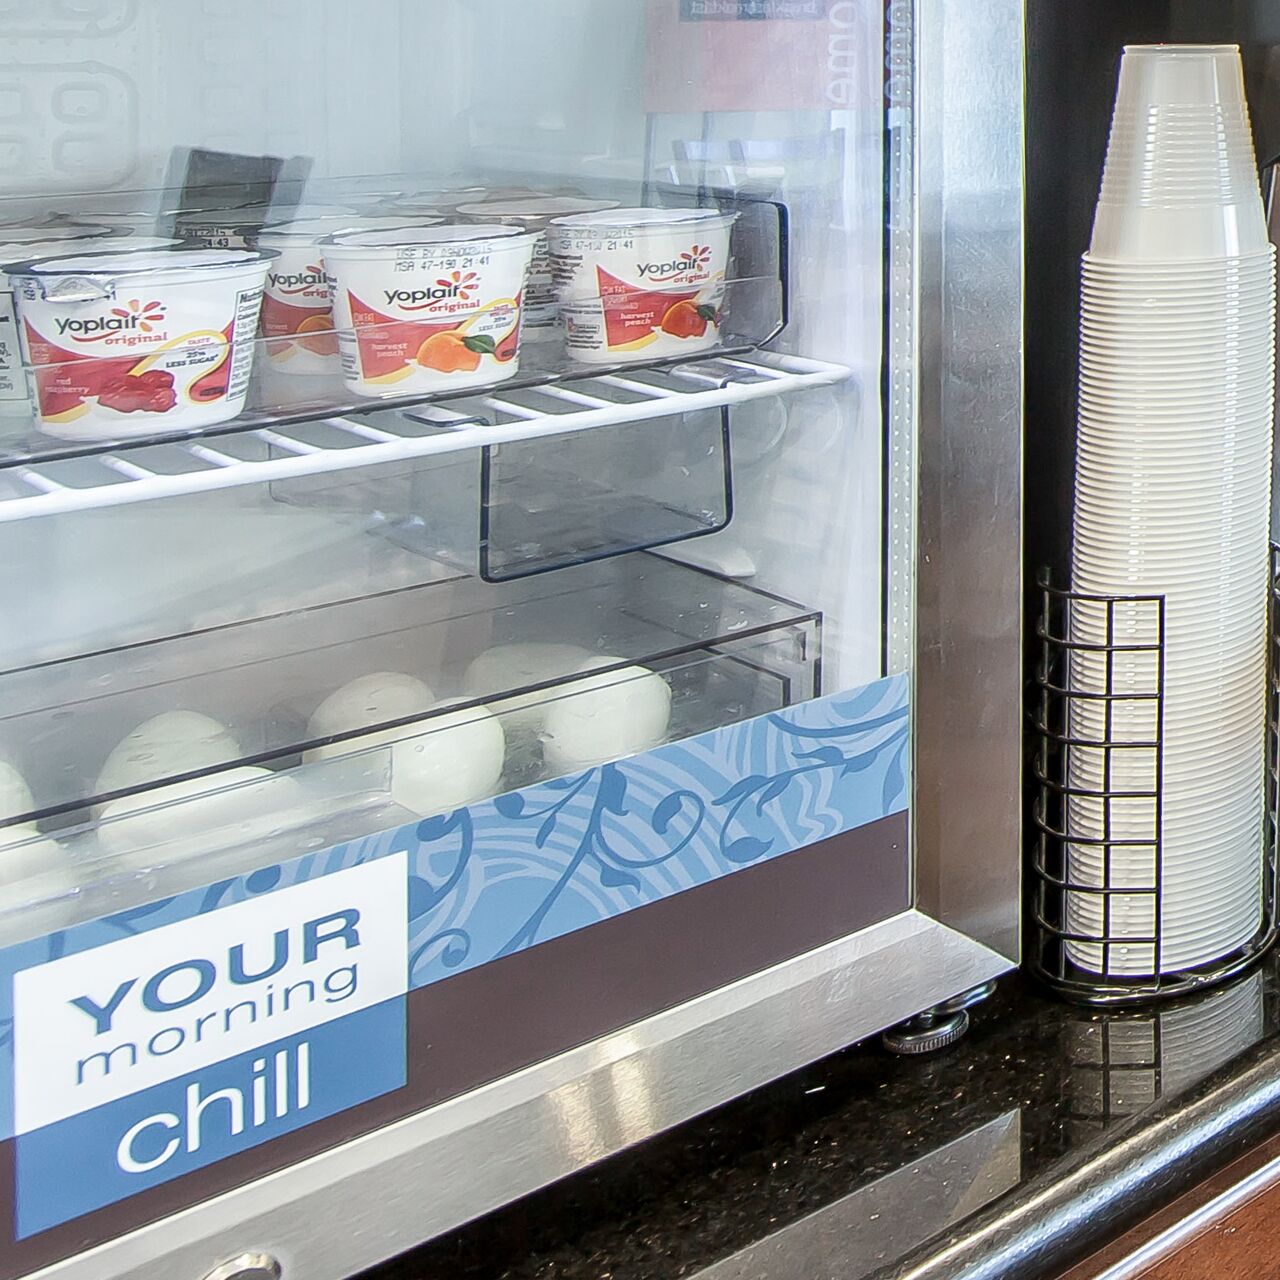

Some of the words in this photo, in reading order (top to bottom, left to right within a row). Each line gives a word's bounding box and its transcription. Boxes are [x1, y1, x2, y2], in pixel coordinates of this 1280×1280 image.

[673, 270, 710, 283] original
[429, 299, 480, 314] original
[620, 311, 655, 320] harvest
[625, 319, 652, 328] peach
[104, 331, 168, 347] original
[166, 359, 187, 368] LESS
[67, 909, 362, 1037] YOUR
[75, 963, 359, 1086] morning
[117, 1042, 311, 1174] chill
